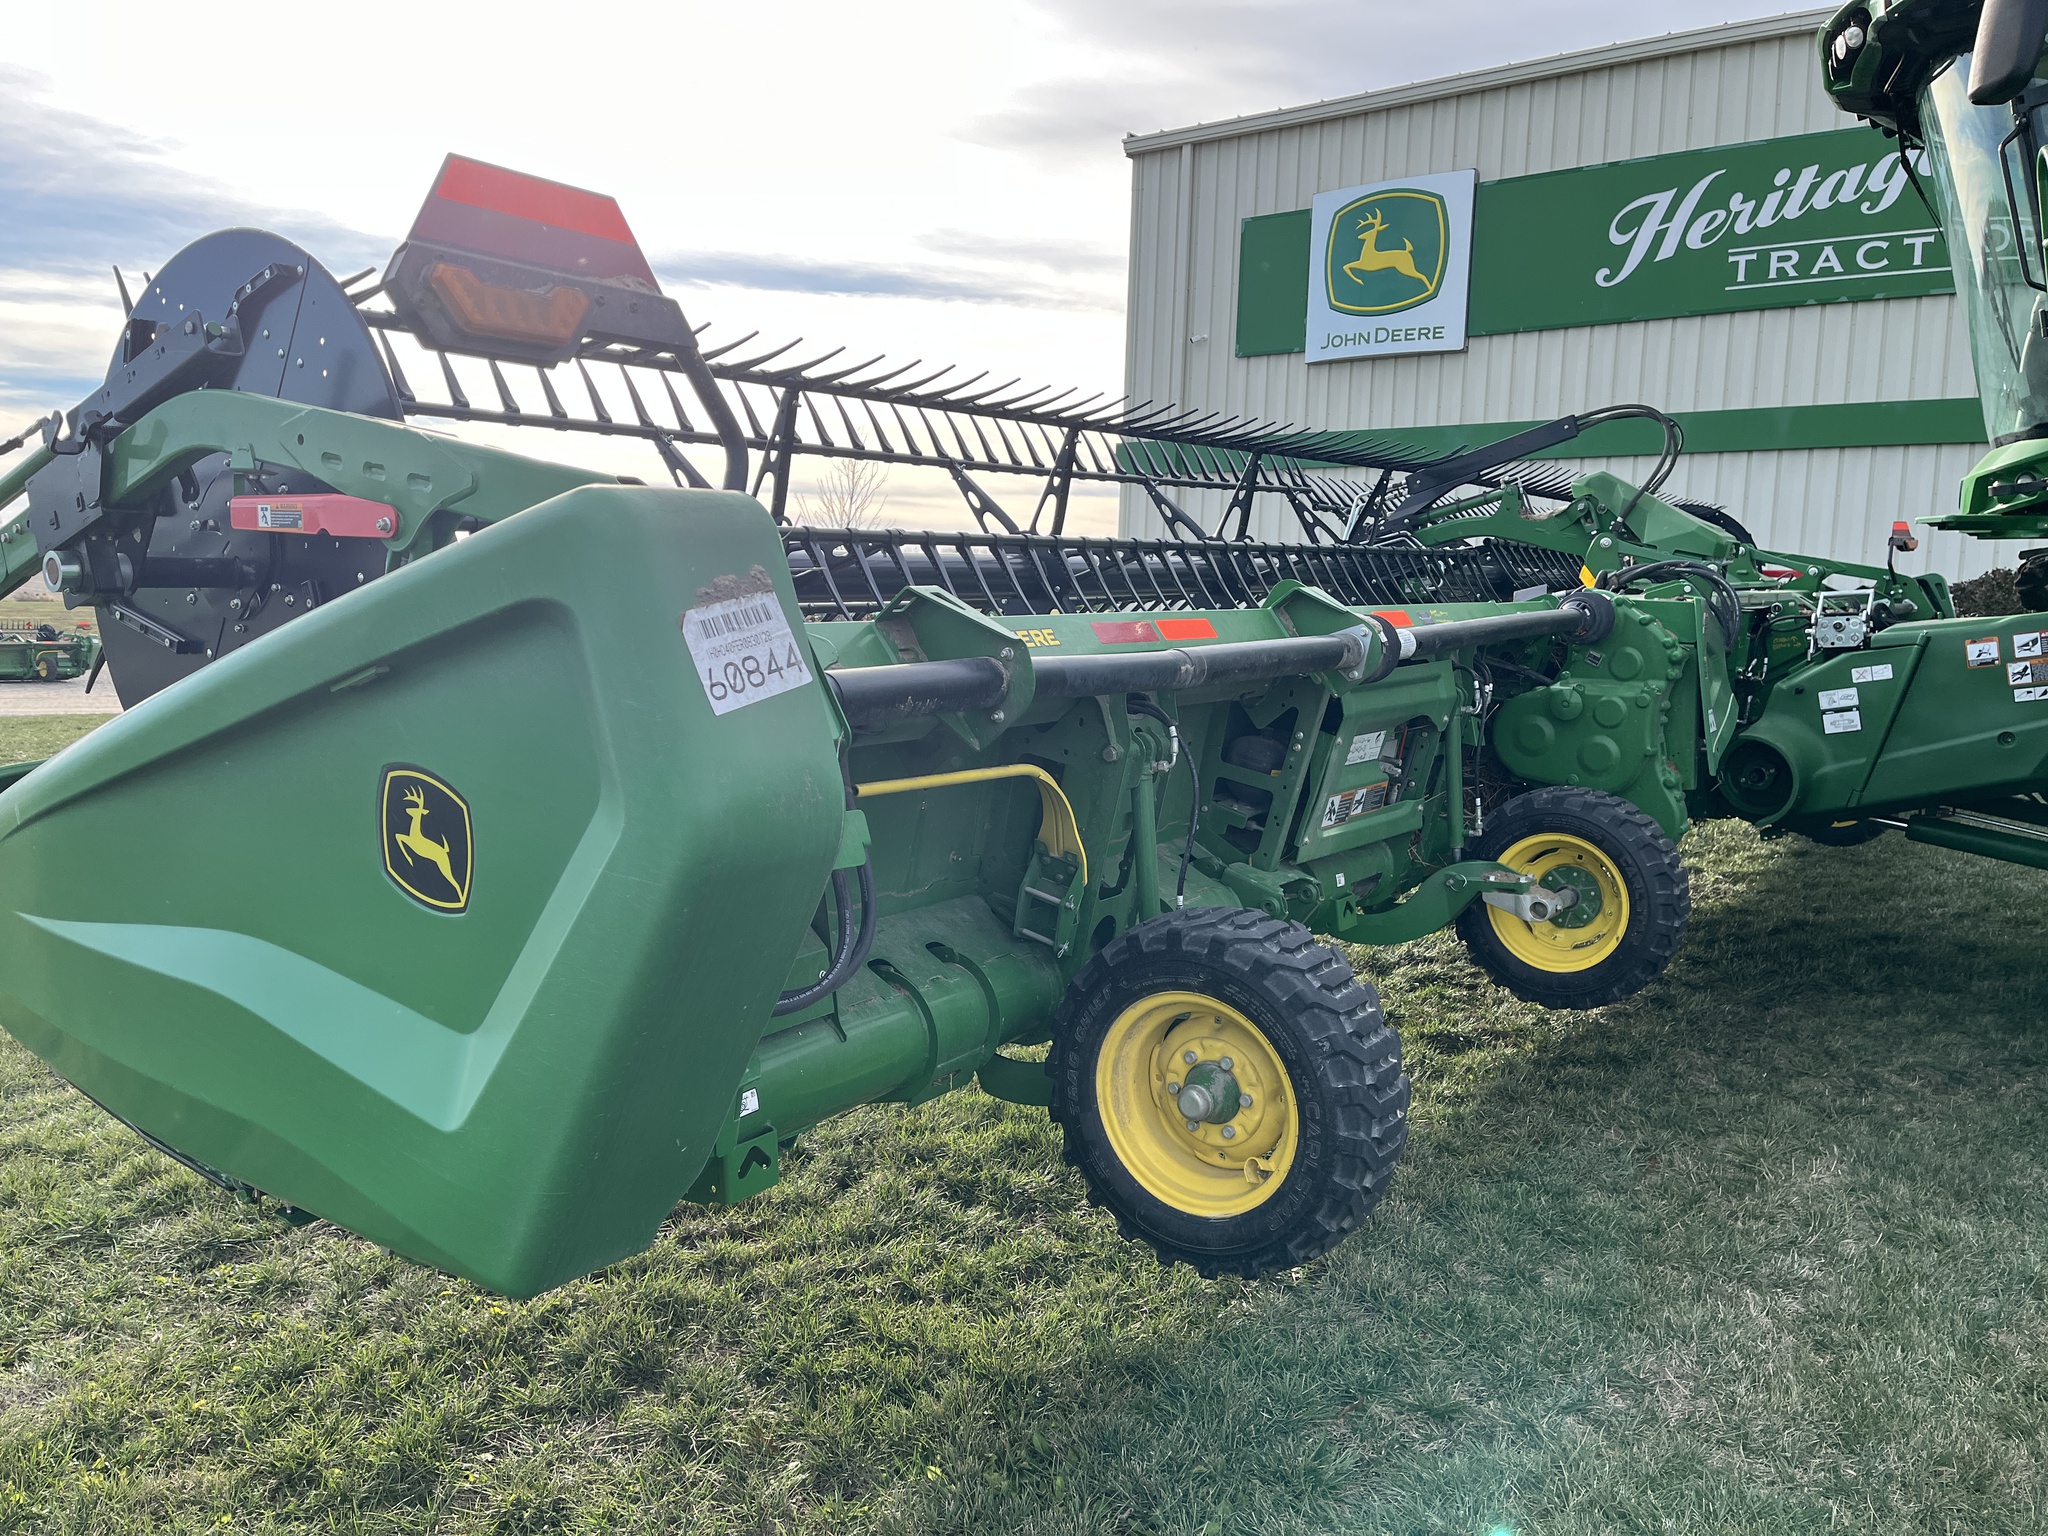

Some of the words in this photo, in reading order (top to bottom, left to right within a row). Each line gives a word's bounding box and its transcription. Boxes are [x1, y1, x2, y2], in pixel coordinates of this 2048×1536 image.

[1320, 332, 1371, 350] JOHN
[1374, 326, 1445, 344] DEERE
[126, 372, 133, 384] 2
[155, 350, 161, 360] 3
[1014, 628, 1062, 648] ERE
[708, 642, 803, 701] 60844
